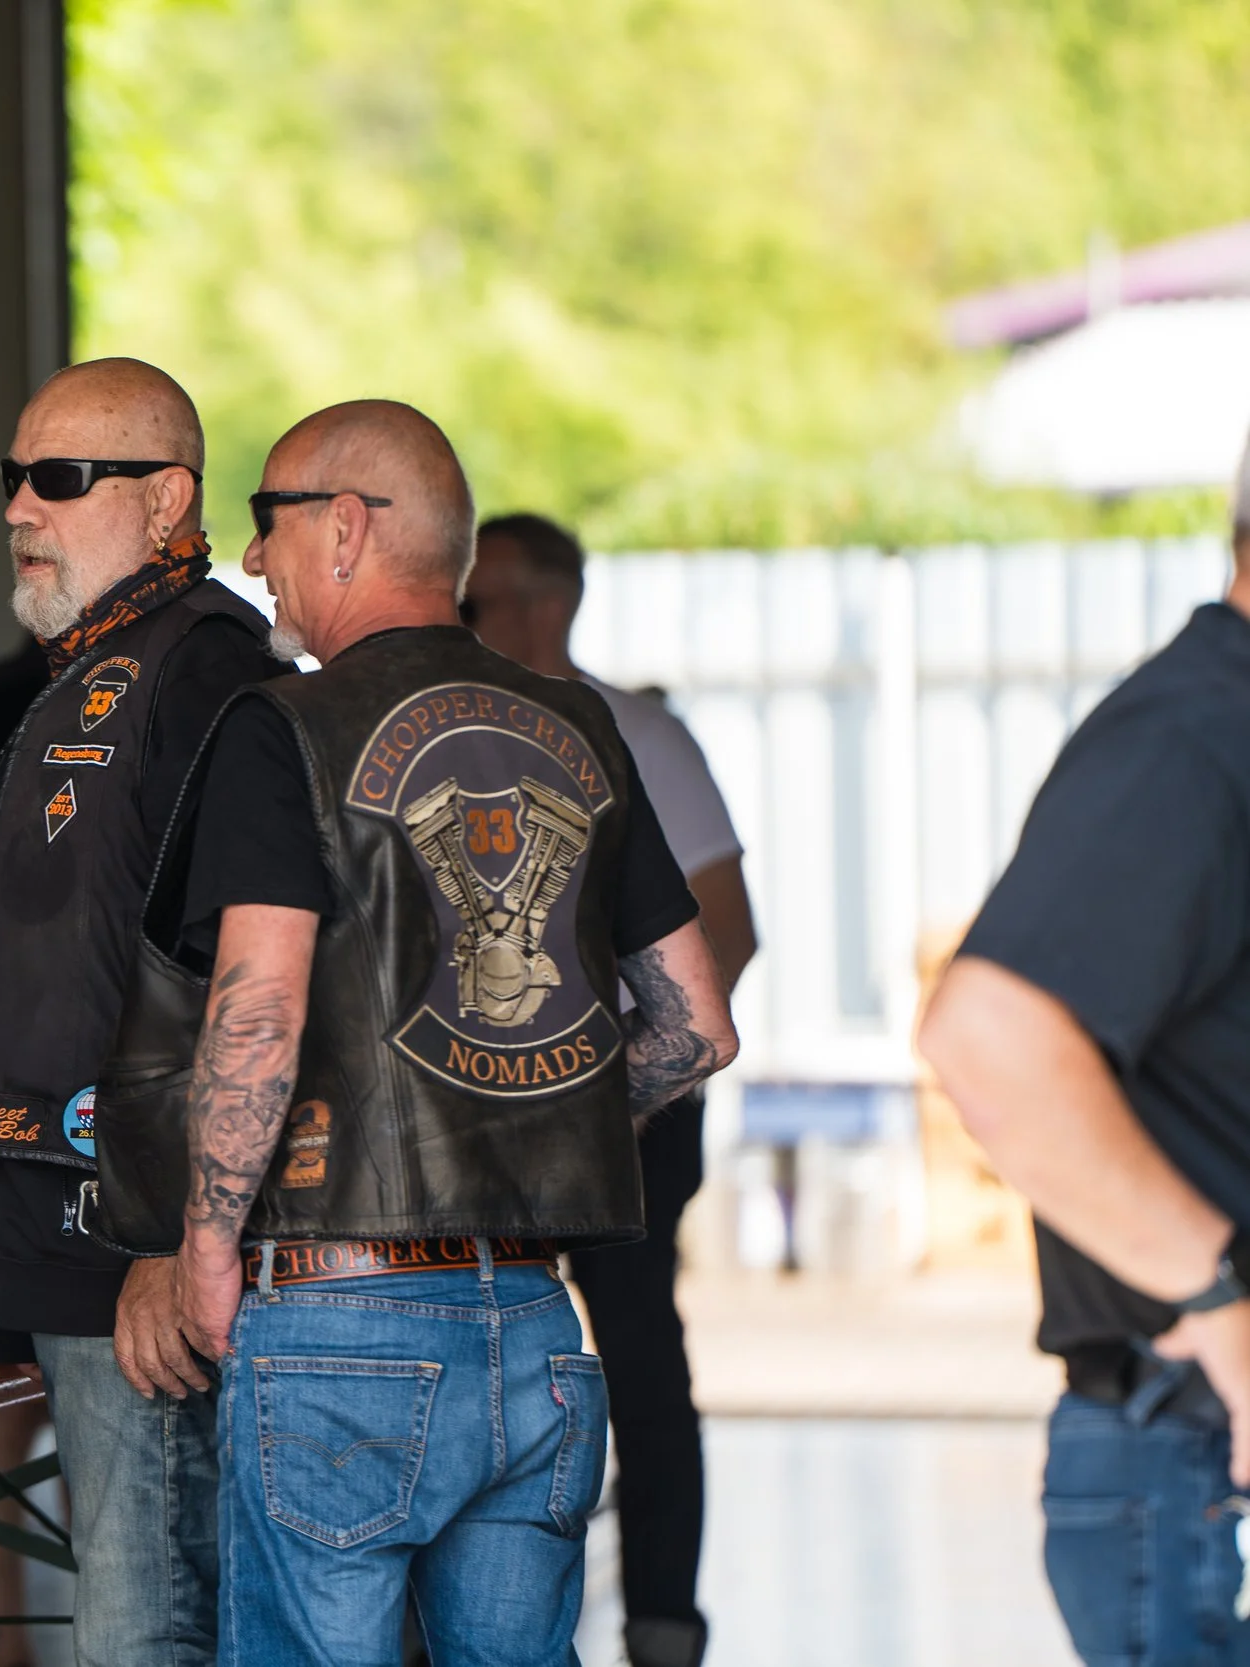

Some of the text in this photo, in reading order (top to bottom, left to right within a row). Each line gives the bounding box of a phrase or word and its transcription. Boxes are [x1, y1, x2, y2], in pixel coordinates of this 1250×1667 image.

[84, 691, 115, 716] 33
[53, 748, 104, 761] Regensburg
[361, 692, 603, 800] CHOPPER CREW
[48, 803, 73, 817] 2013
[55, 794, 72, 804] EST
[466, 808, 517, 855] 33
[445, 1034, 598, 1084] NOMADS
[272, 1238, 438, 1277] CHOPPER
[439, 1235, 523, 1260] CRW
